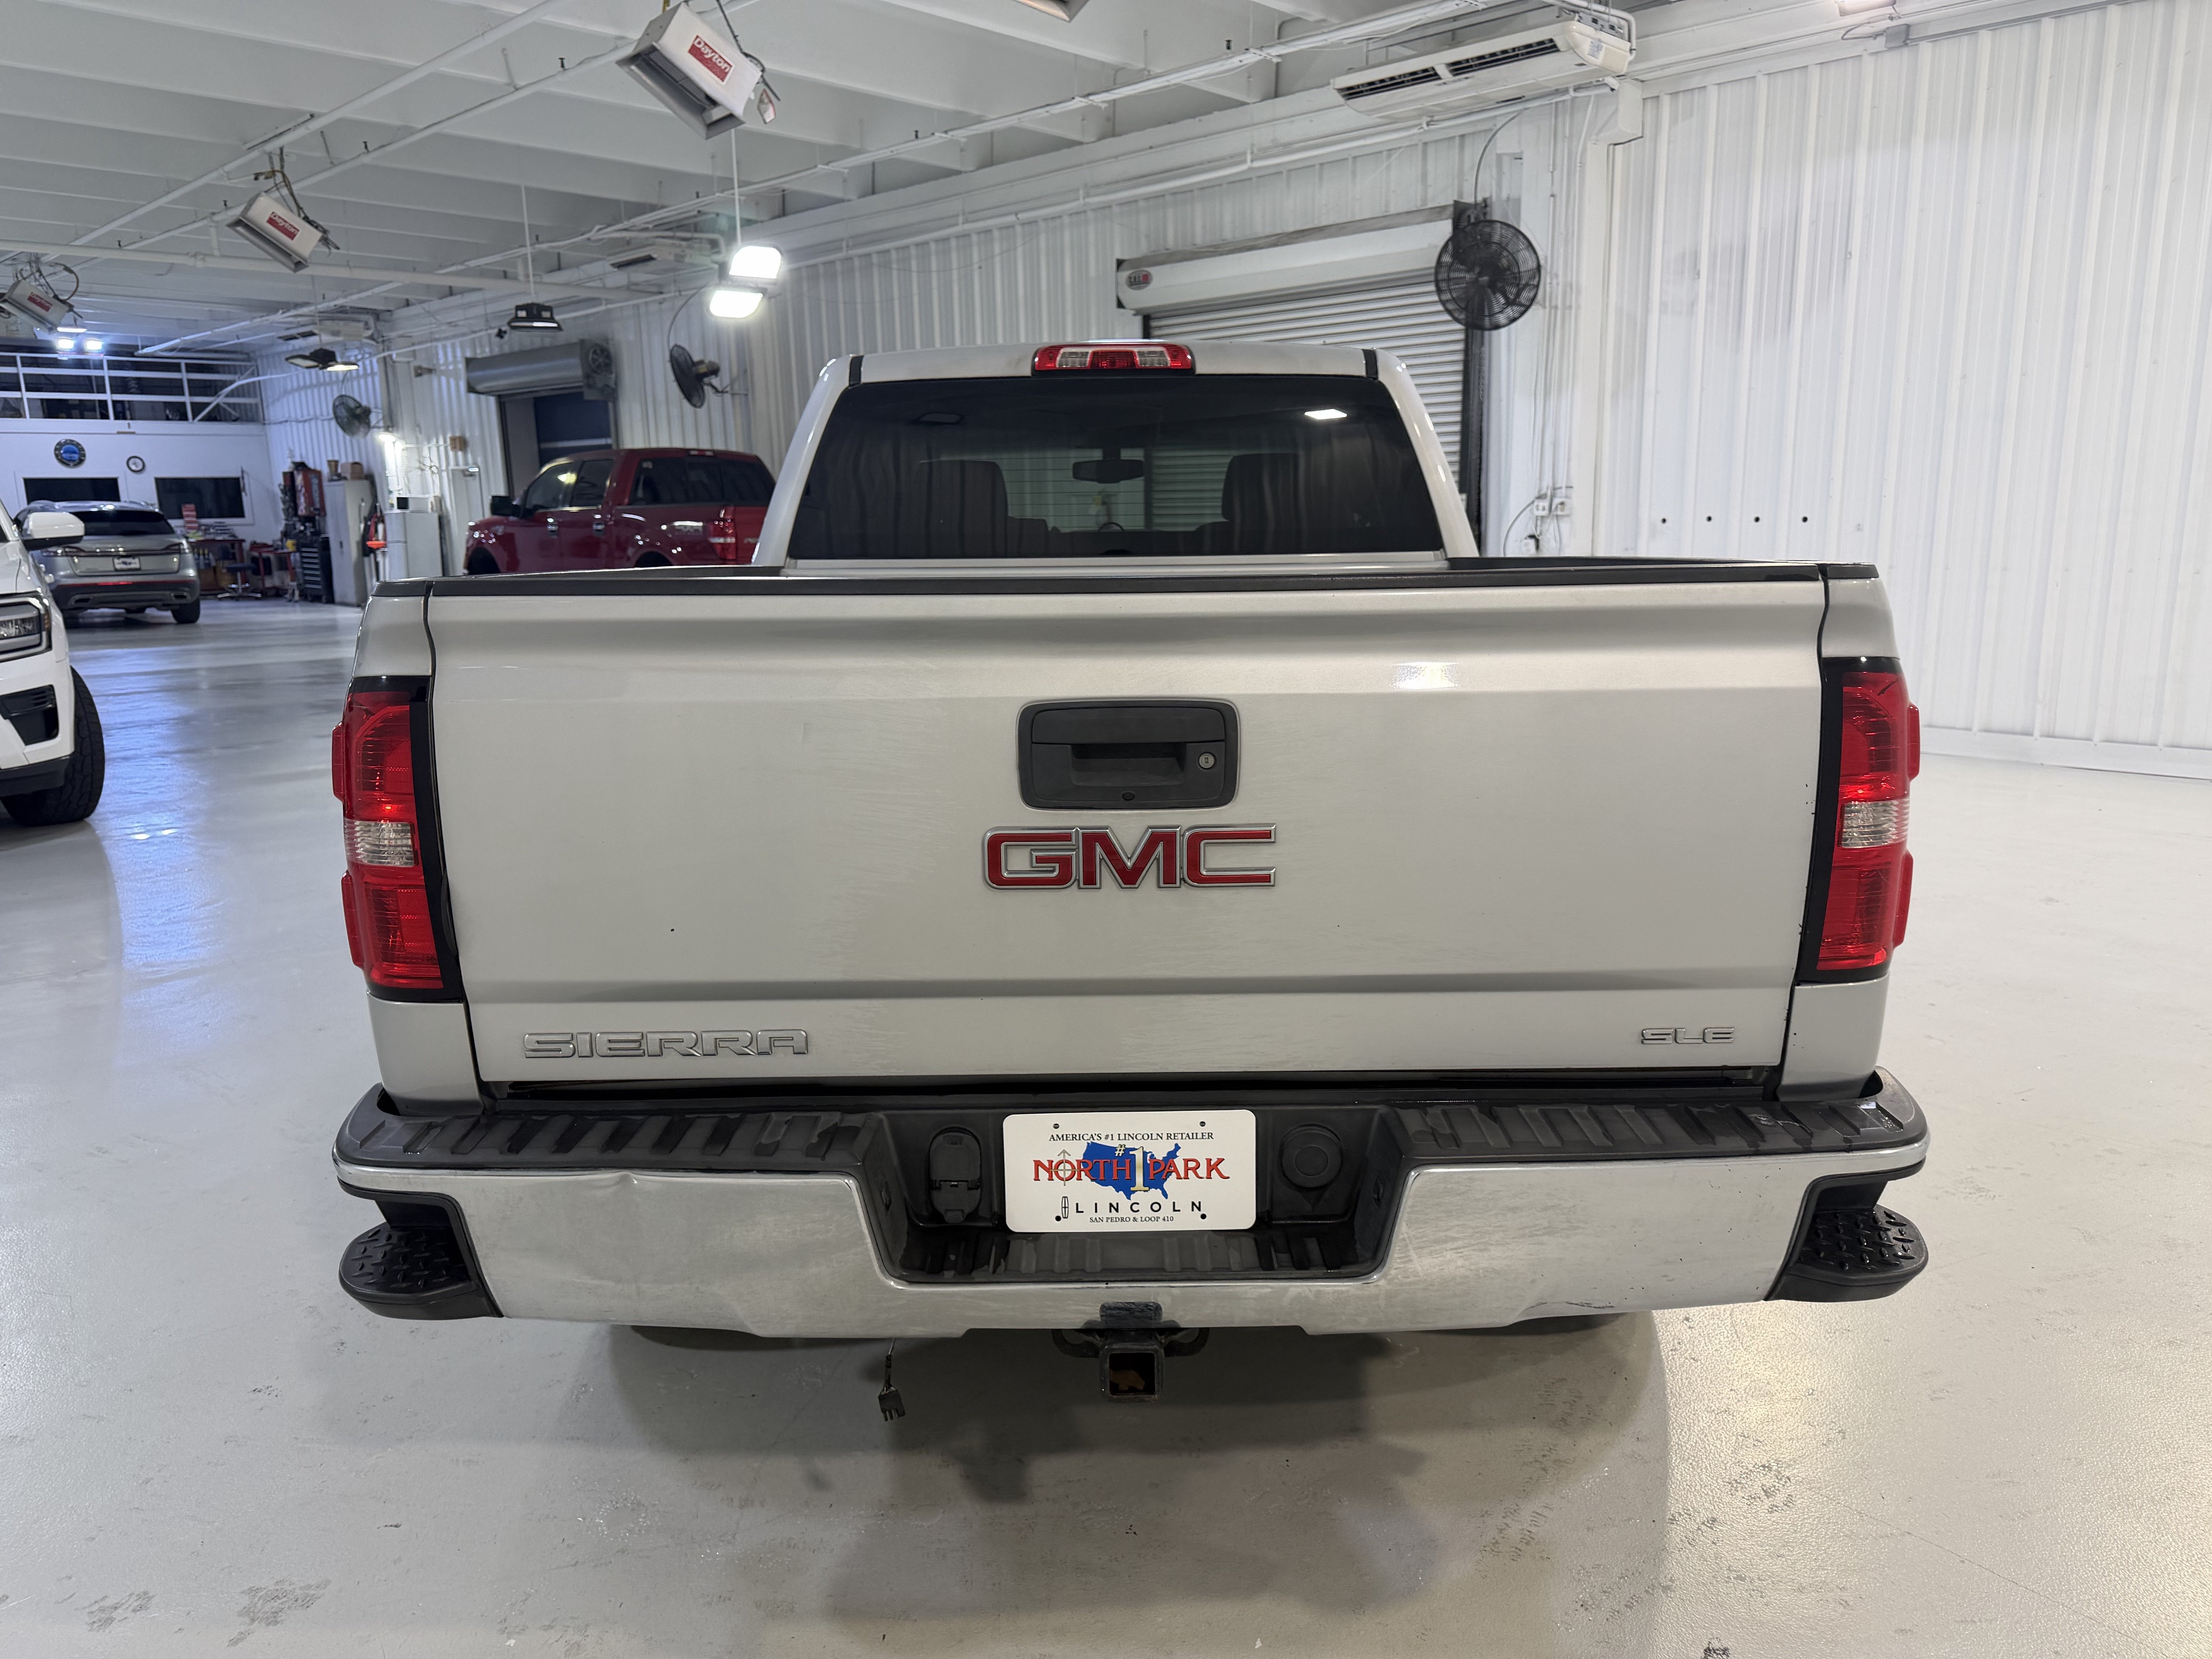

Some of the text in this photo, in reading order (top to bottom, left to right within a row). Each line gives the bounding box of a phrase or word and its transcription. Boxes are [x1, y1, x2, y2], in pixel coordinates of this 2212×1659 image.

[694, 38, 730, 72] Dayton
[982, 824, 1276, 890] GMC
[524, 1029, 809, 1058] SIERRA
[1641, 1027, 1735, 1044] SLE
[1049, 1133, 1102, 1141] AMERICA'S
[1166, 1132, 1214, 1140] RETAILER
[1033, 1158, 1230, 1182] NORTH PARK
[1075, 1201, 1202, 1214] LINCOLN
